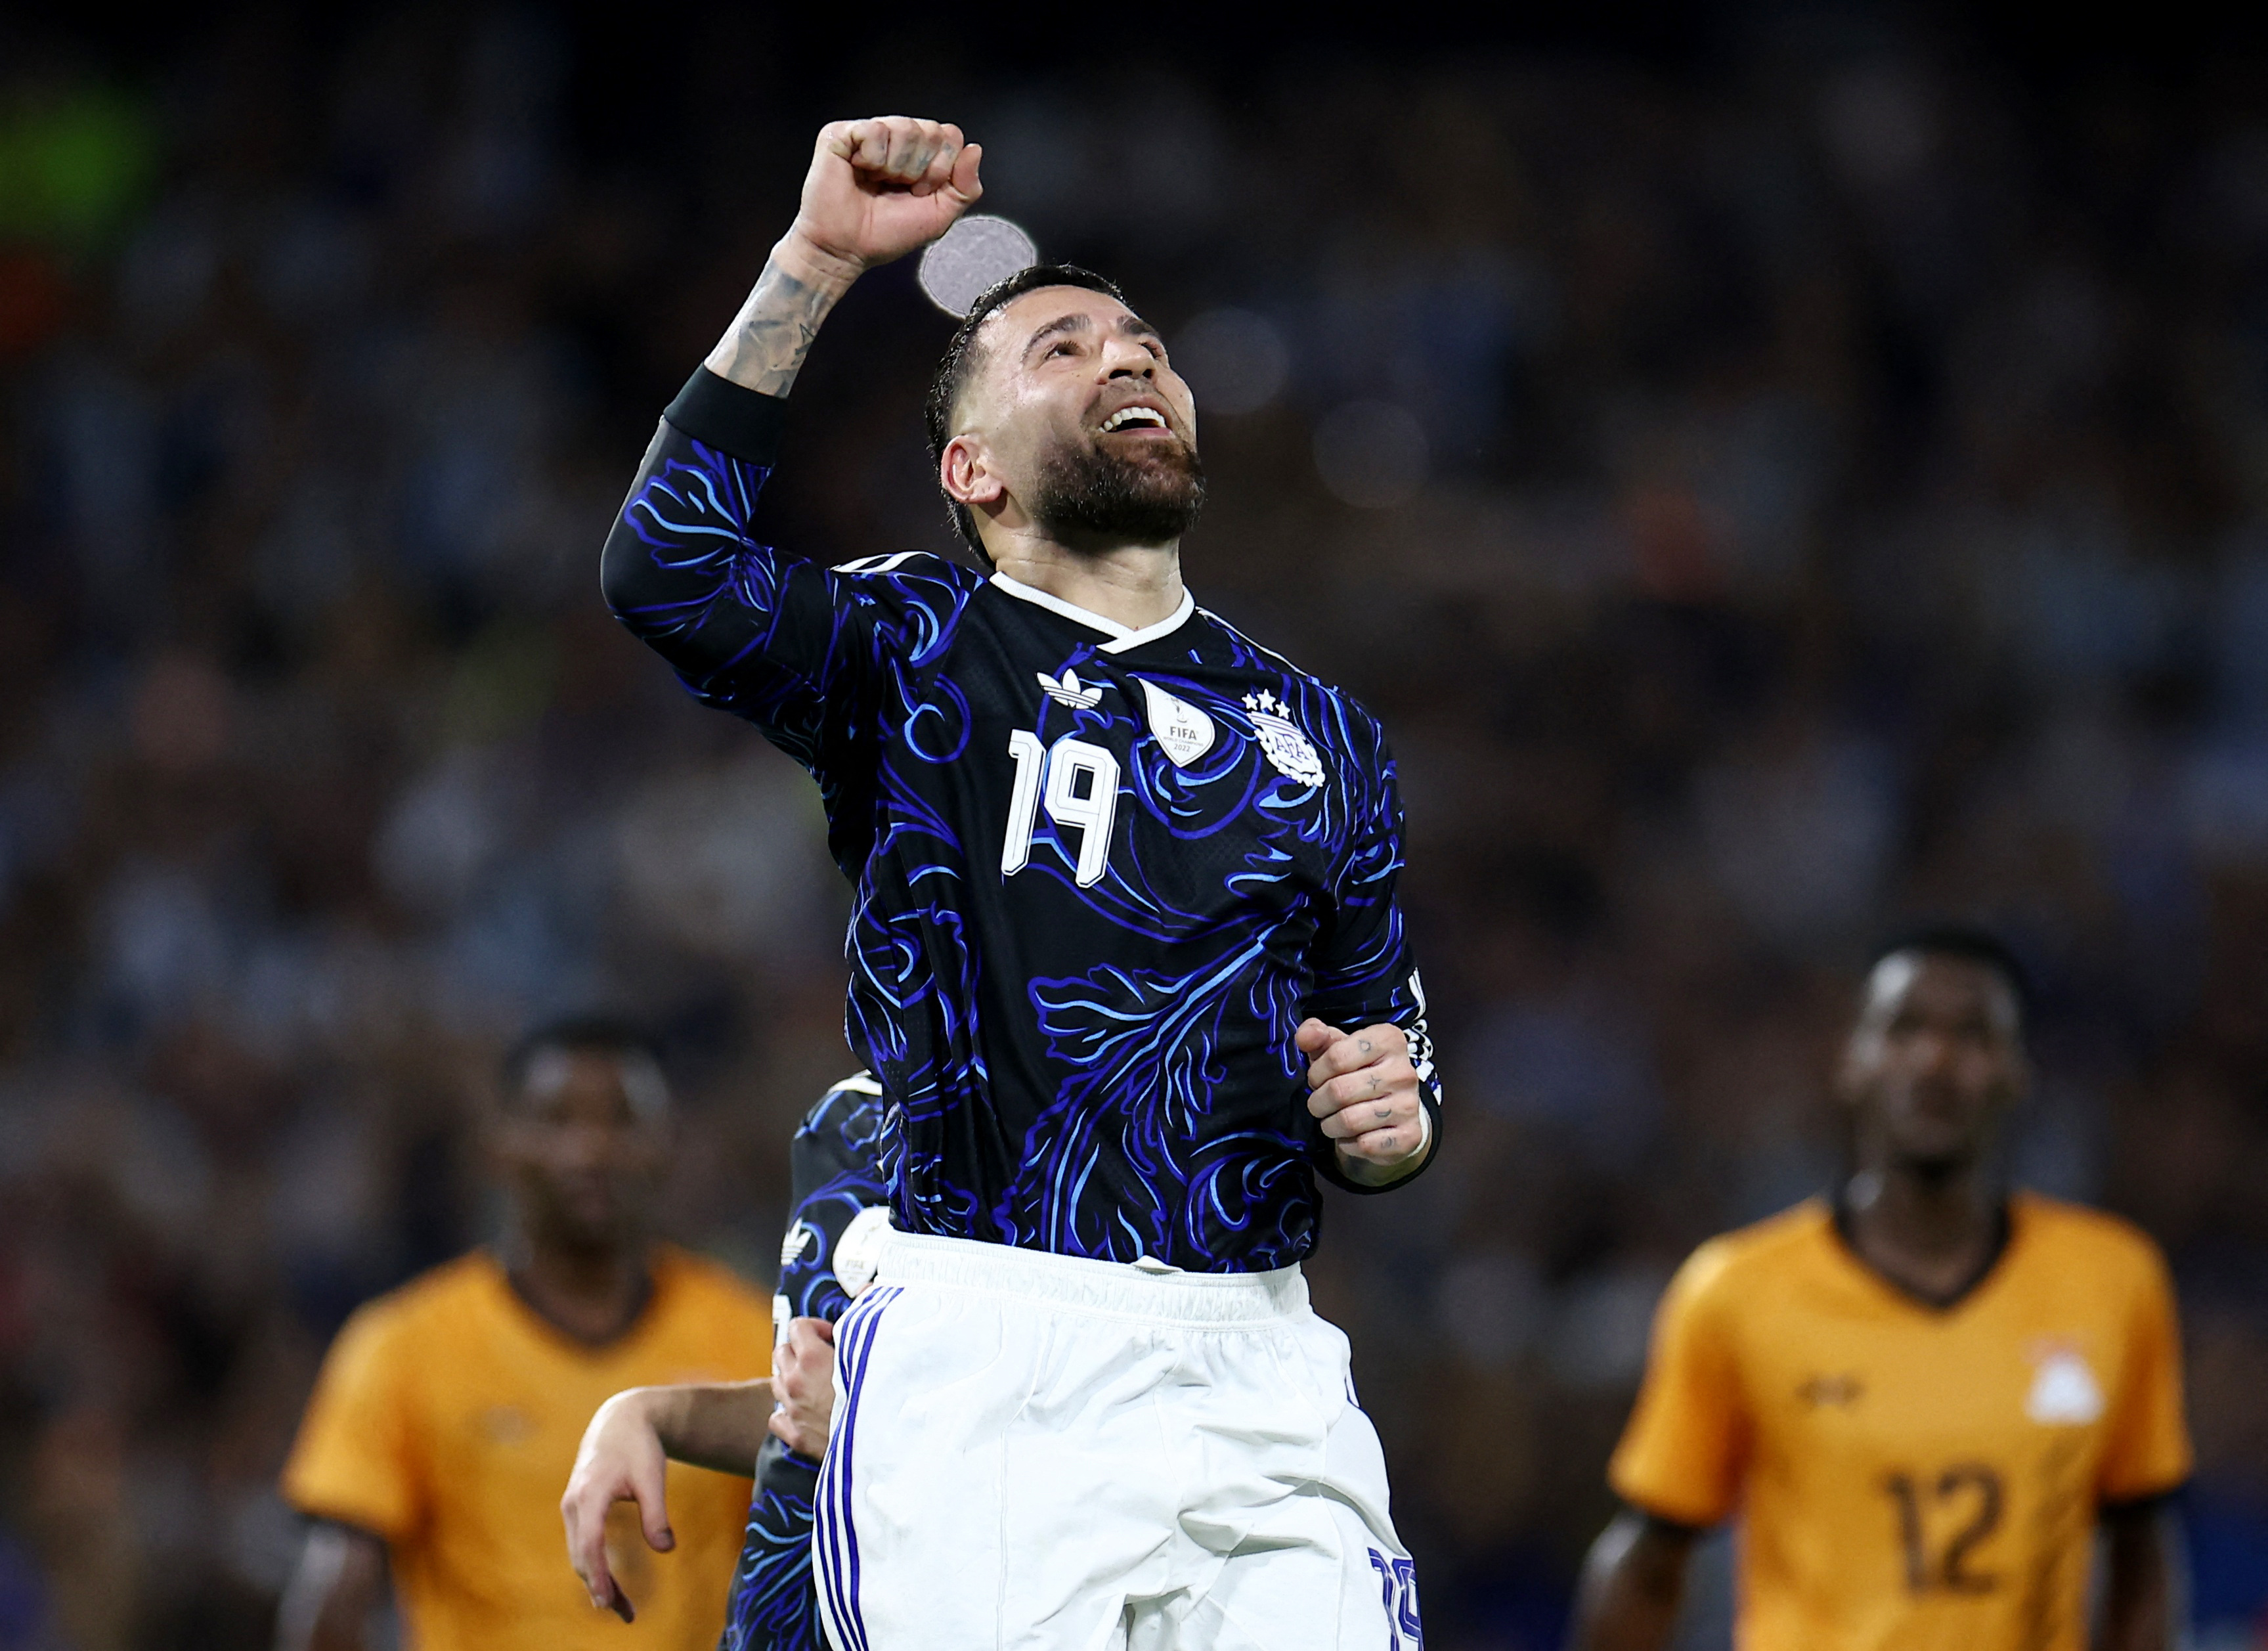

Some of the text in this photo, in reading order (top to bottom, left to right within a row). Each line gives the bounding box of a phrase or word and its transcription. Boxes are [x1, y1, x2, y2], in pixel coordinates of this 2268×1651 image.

[1169, 726, 1196, 741] FIFA
[1173, 743, 1190, 752] 2022
[1273, 730, 1310, 763] AFA
[1001, 729, 1121, 889] 19
[1879, 1461, 2004, 1598] 12
